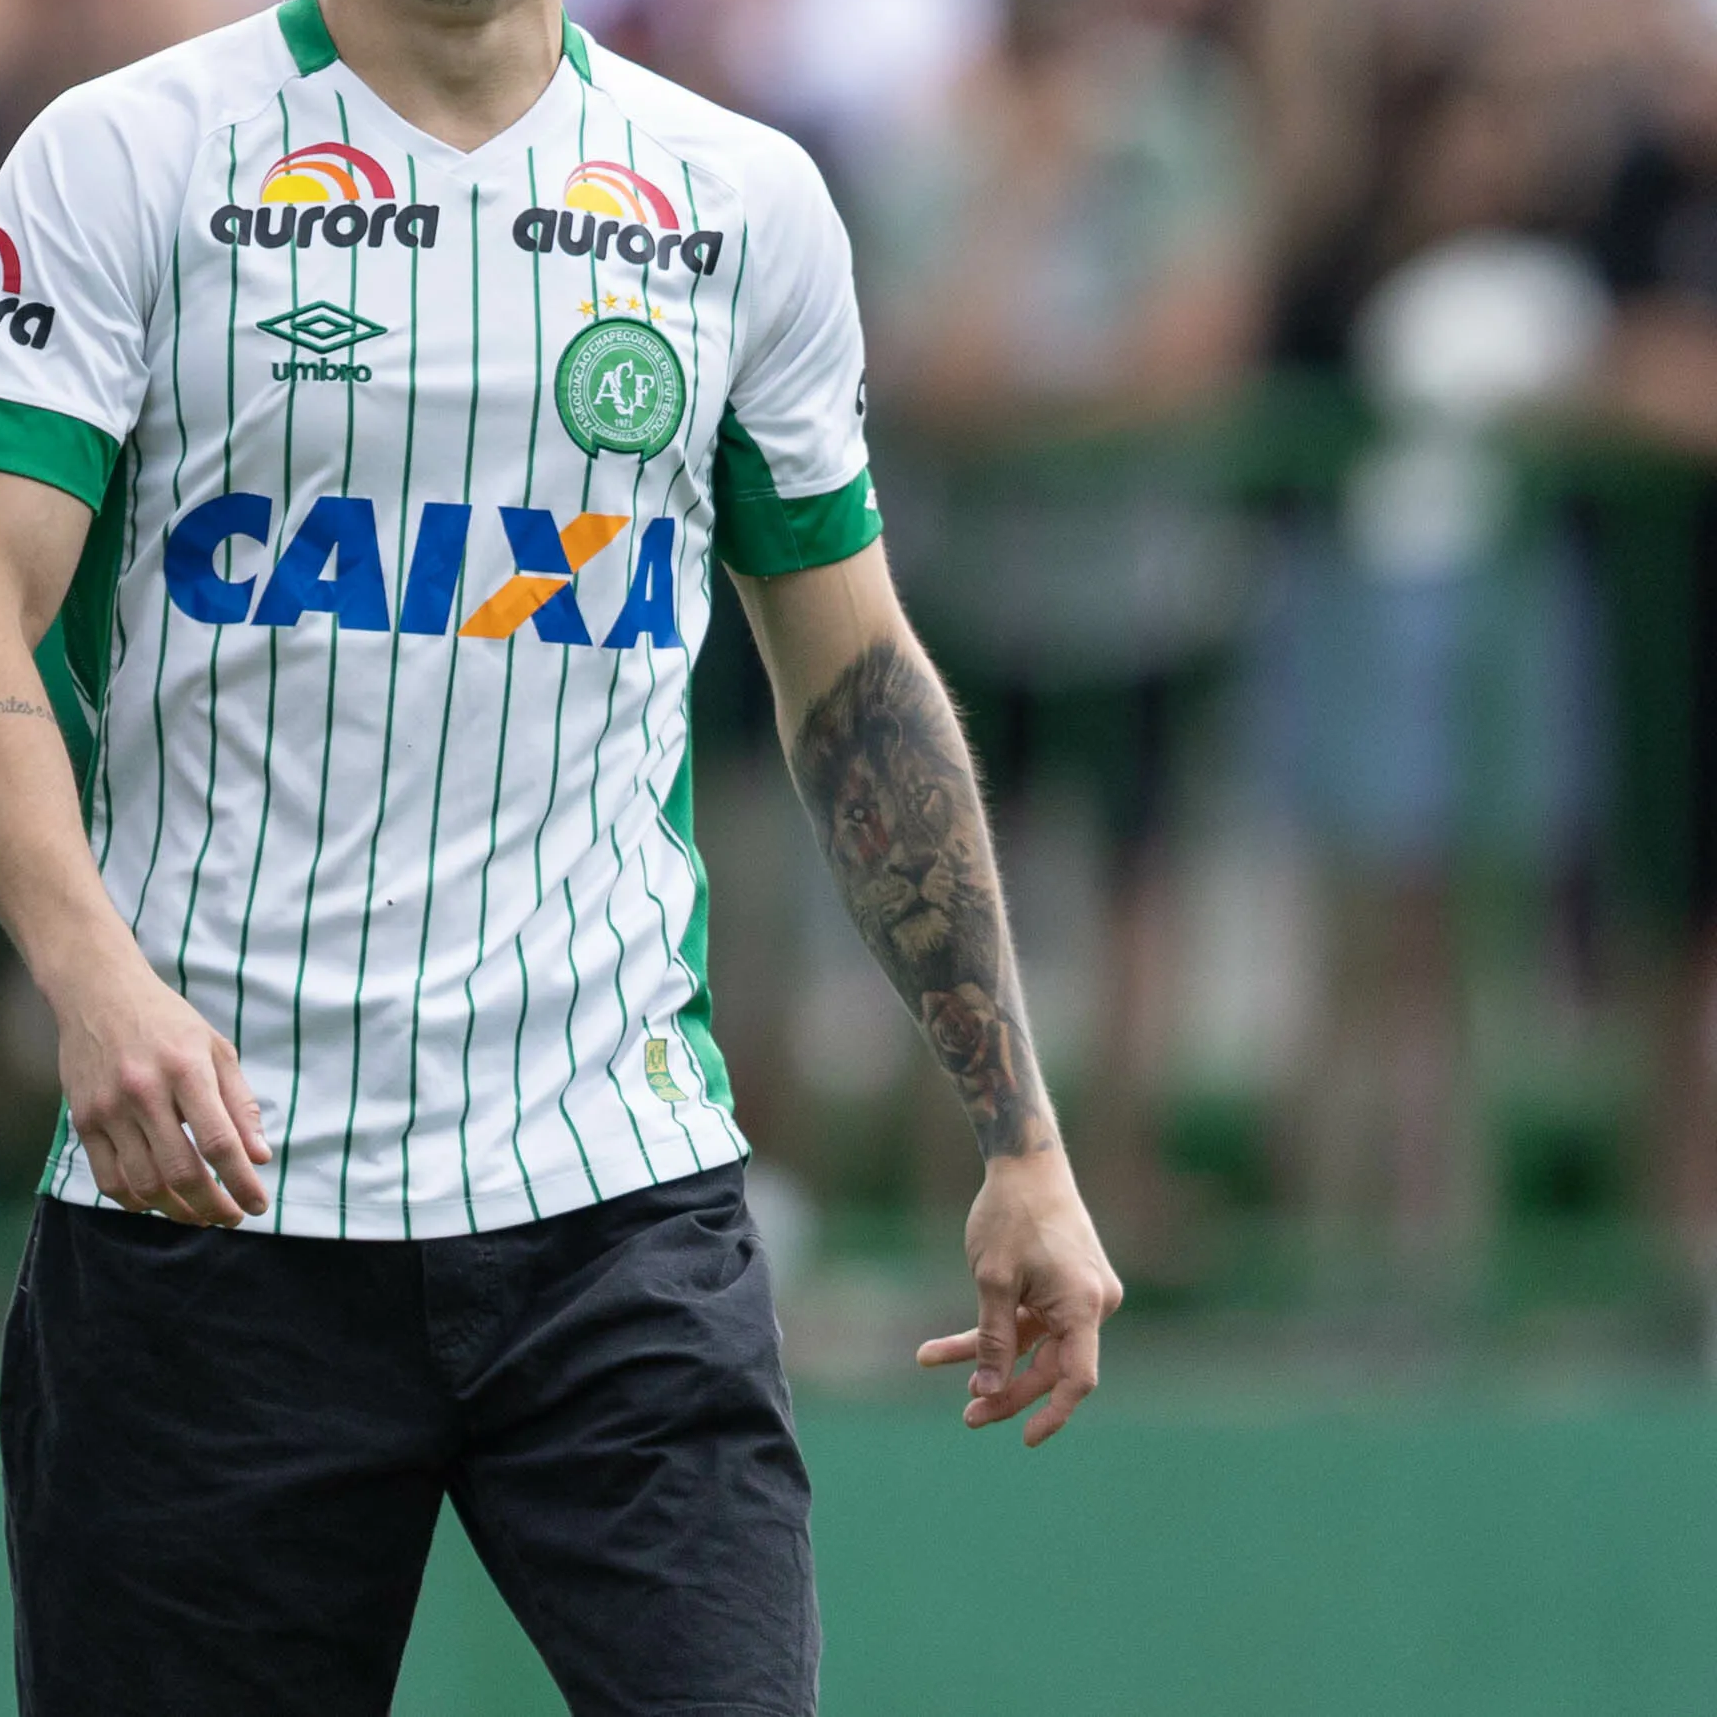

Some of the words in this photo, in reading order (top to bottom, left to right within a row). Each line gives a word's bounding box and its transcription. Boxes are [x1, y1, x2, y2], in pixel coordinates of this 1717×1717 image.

[211, 203, 440, 249] aurora
[512, 206, 724, 277] aurora
[588, 331, 664, 361] CHAPECOENSE
[271, 357, 372, 383] umbro
[166, 491, 682, 651] CAIXA
